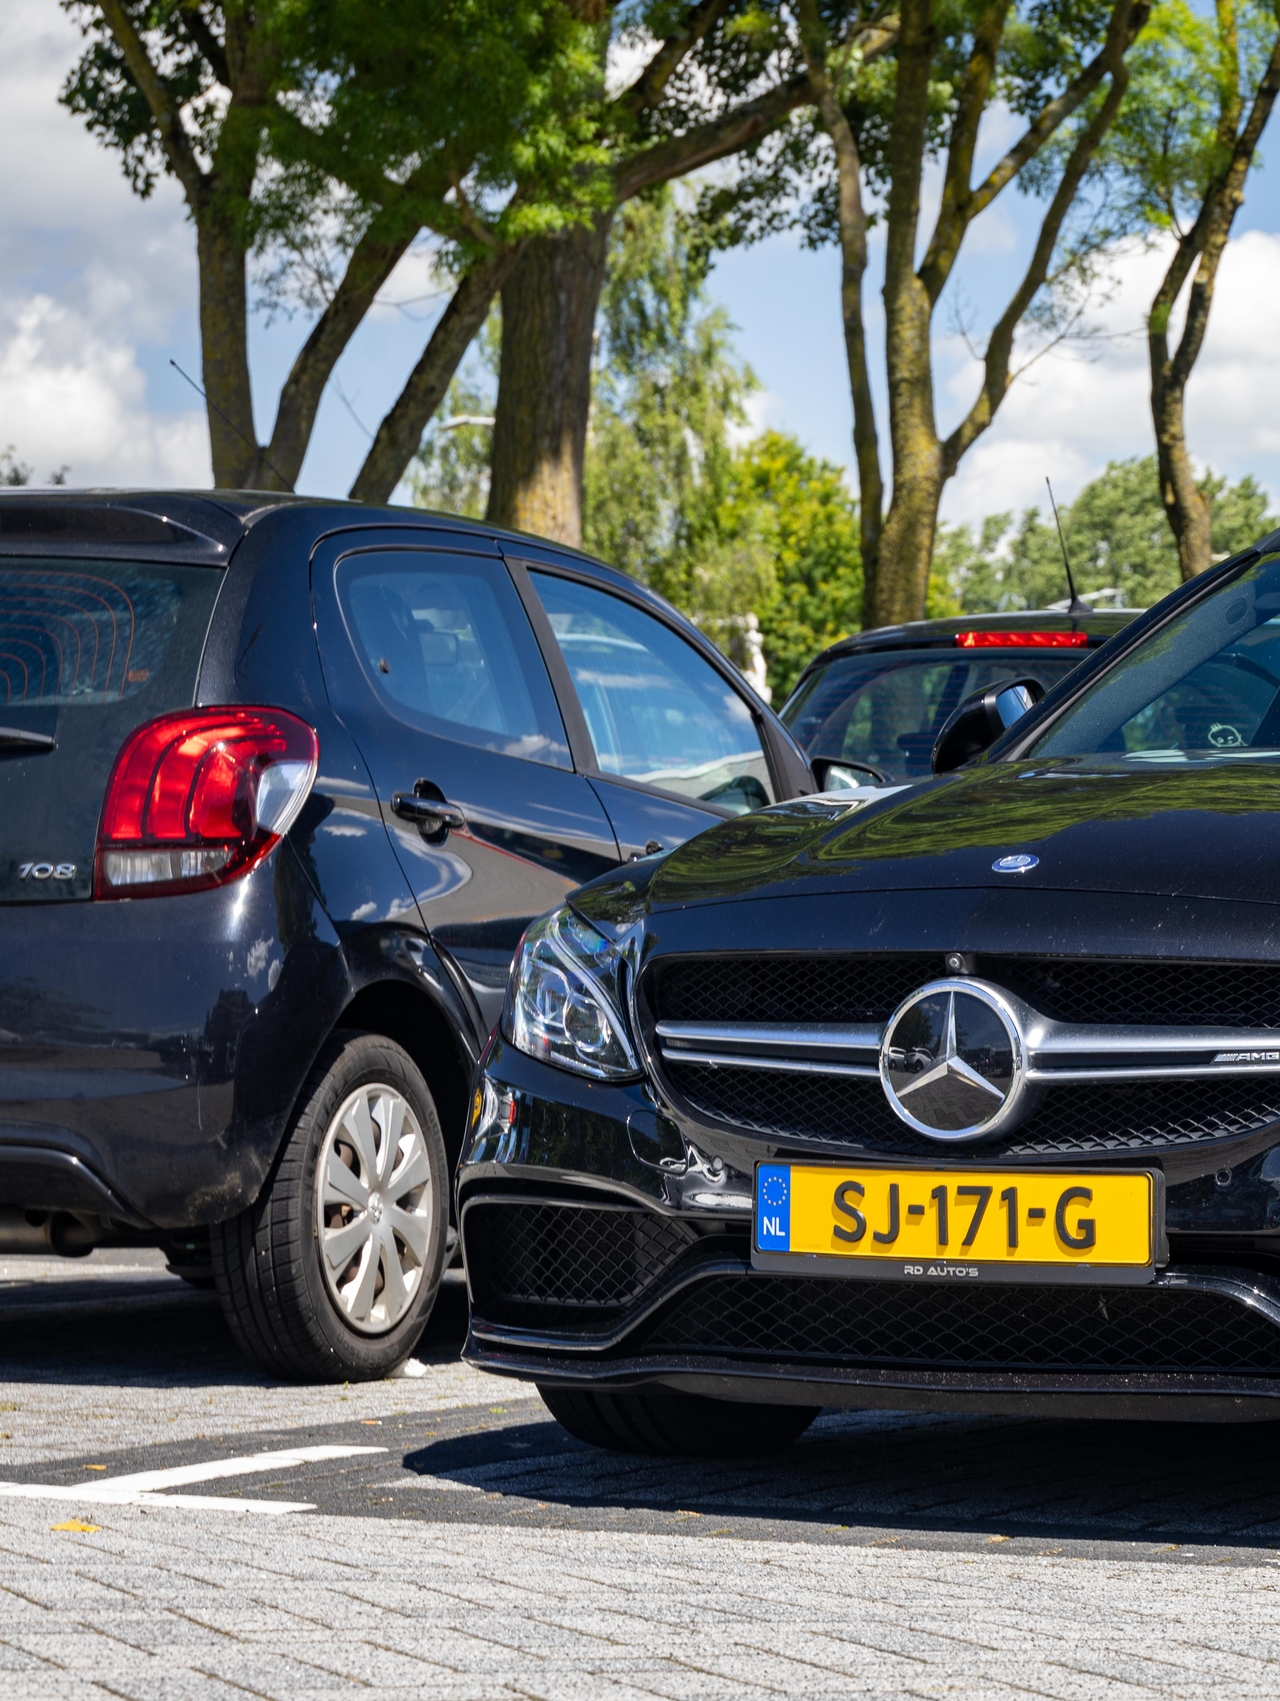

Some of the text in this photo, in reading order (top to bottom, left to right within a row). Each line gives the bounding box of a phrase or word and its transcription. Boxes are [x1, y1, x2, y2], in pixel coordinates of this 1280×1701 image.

[19, 862, 75, 880] 108
[1234, 1052, 1280, 1062] AMG
[832, 1180, 1097, 1249] SJ-171-G
[762, 1216, 787, 1237] NL
[903, 1265, 979, 1277] RD AUTO'S
